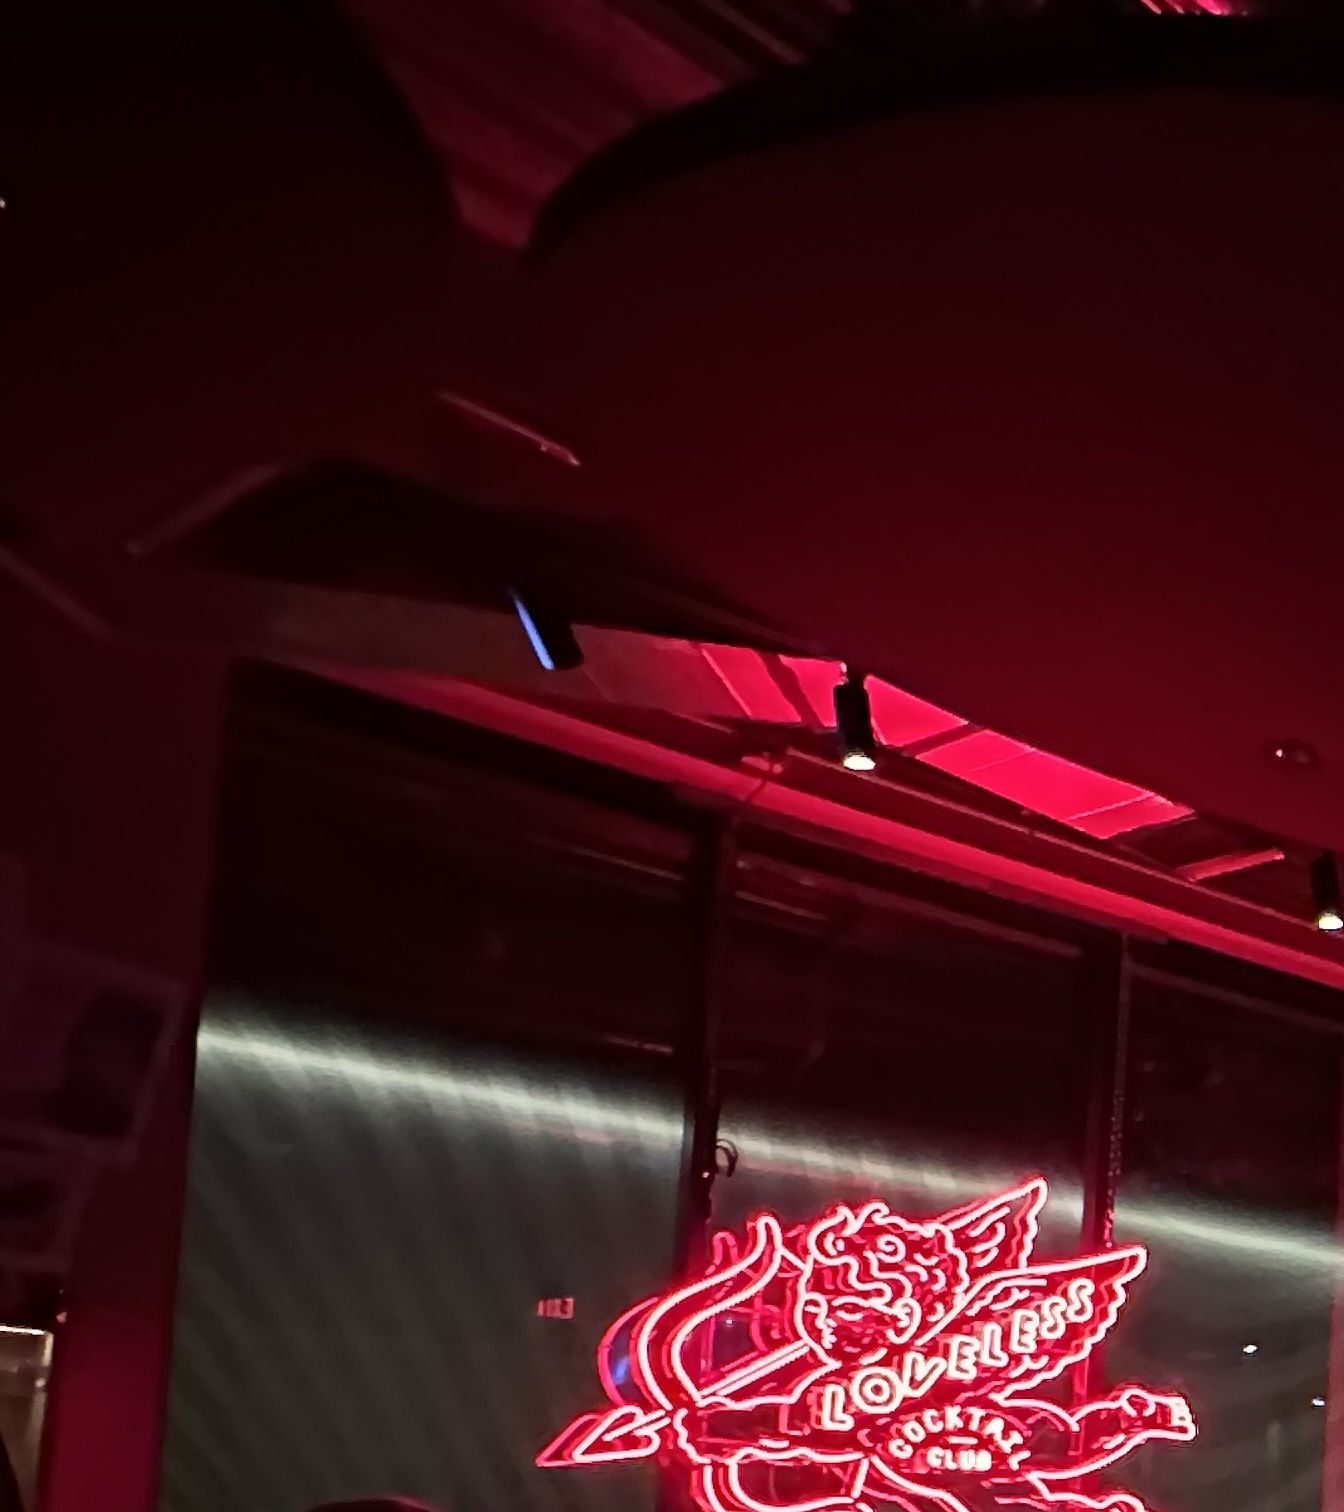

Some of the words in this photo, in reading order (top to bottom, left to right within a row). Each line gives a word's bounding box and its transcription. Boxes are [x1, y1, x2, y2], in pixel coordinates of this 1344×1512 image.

[822, 1278, 1095, 1431] LOVELESS
[888, 1405, 1031, 1470] COCKTAIL
[926, 1448, 992, 1471] CLUB
